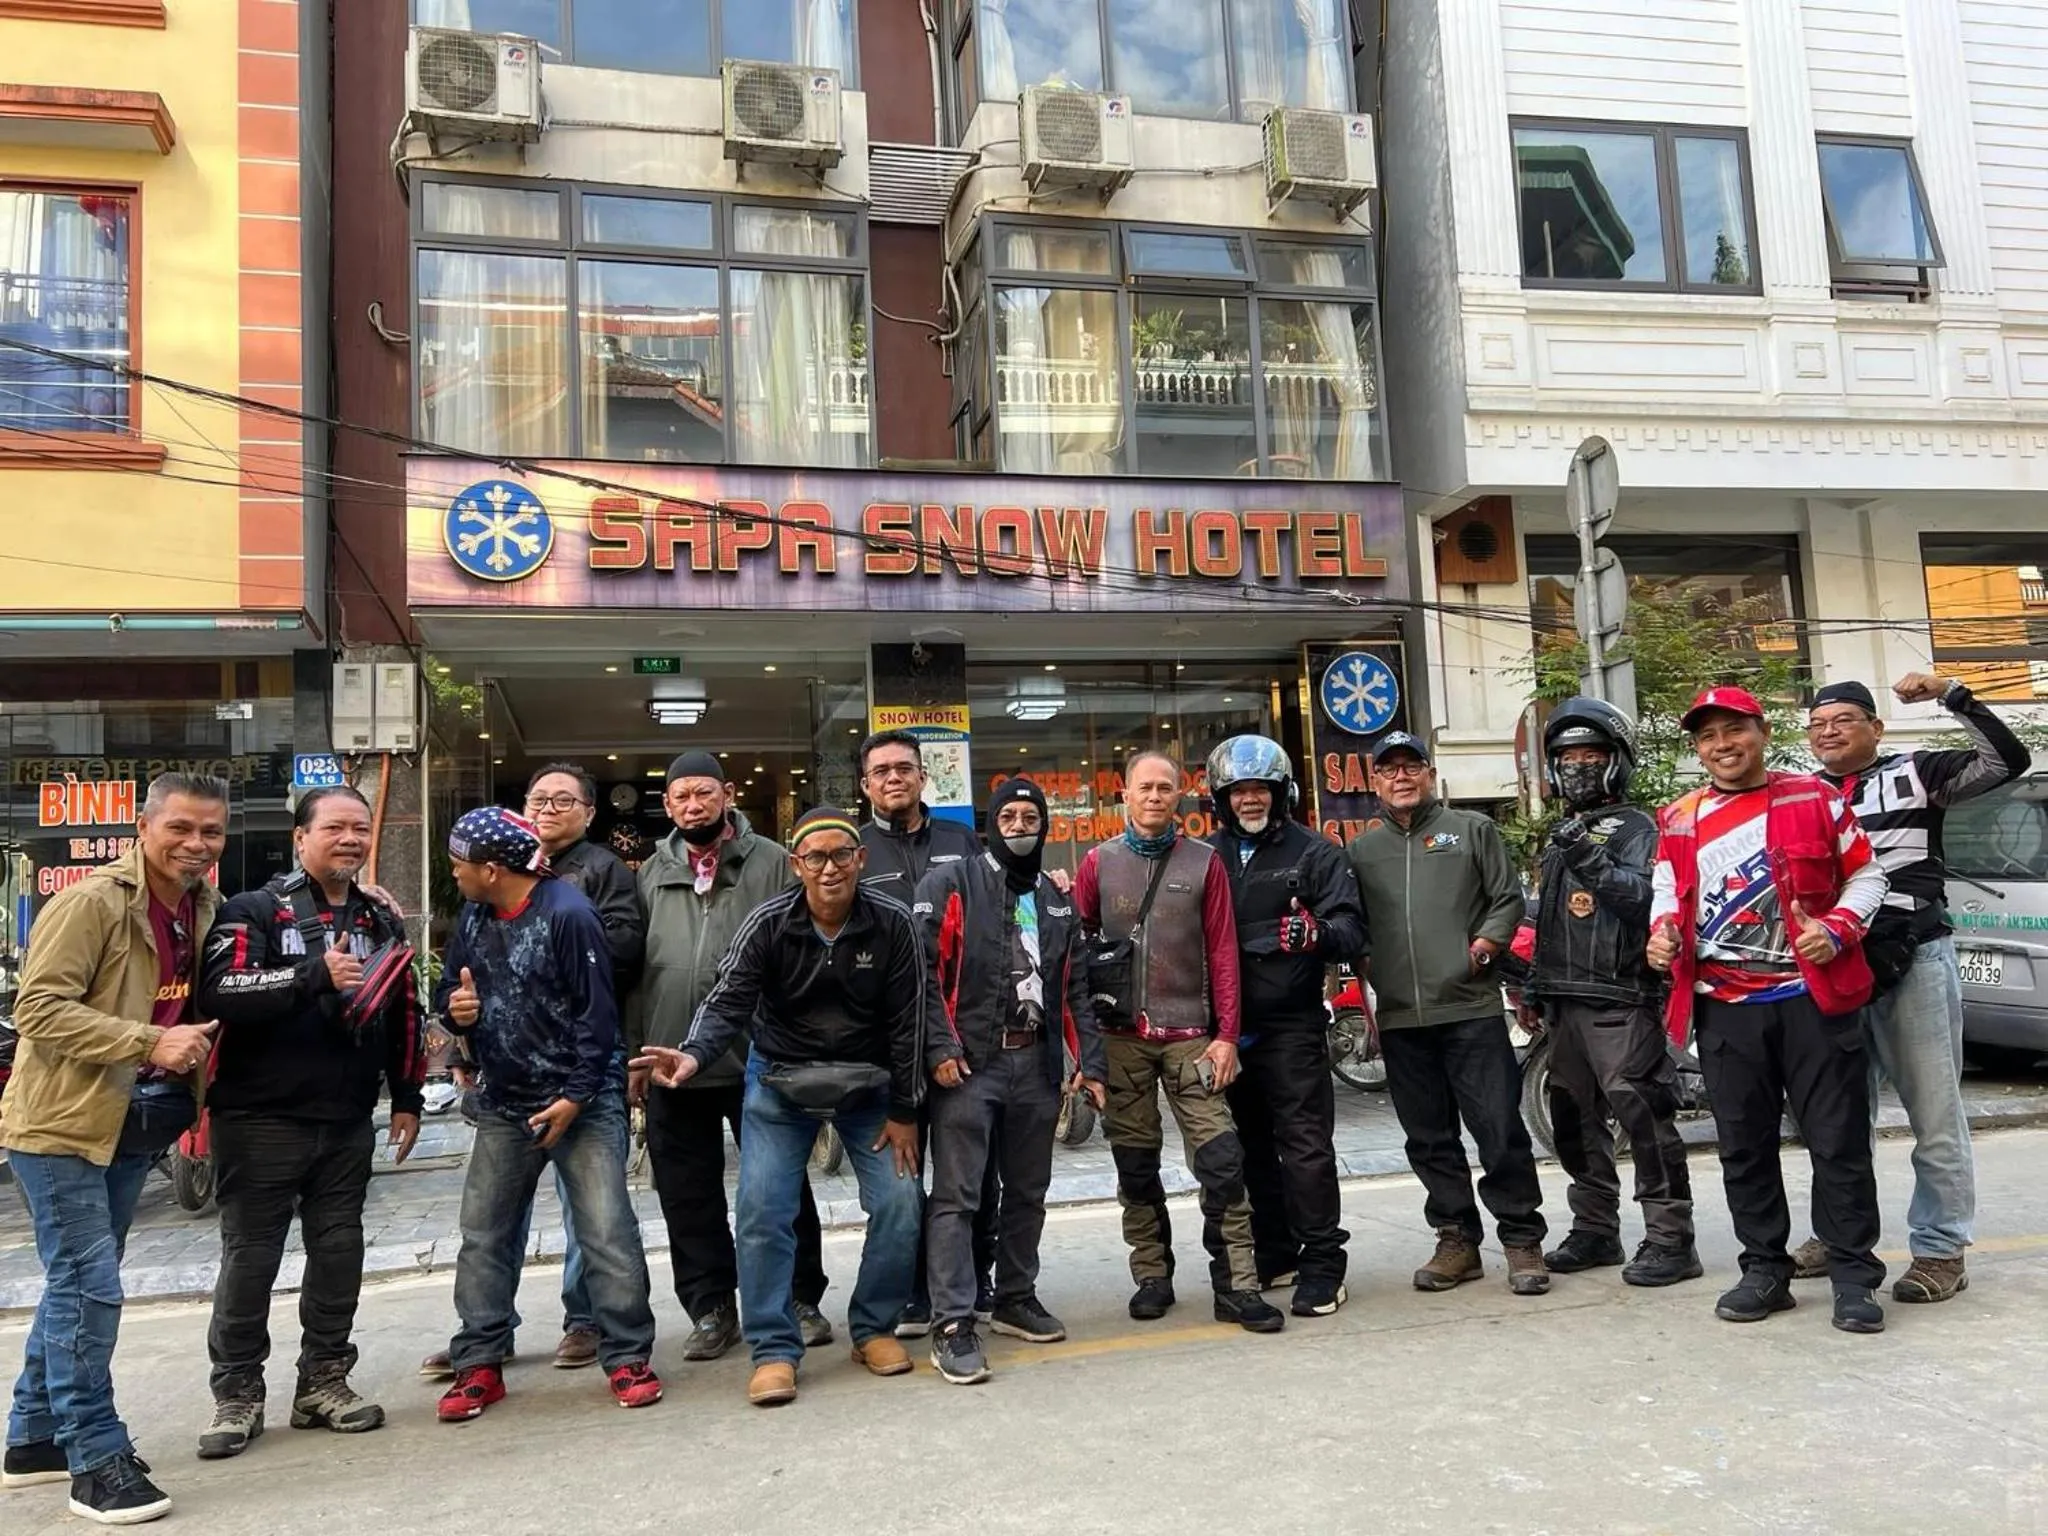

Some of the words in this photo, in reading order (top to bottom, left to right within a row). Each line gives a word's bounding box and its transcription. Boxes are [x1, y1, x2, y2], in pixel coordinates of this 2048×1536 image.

[589, 497, 836, 573] SAPA
[863, 503, 1109, 577] SNOW
[1134, 508, 1388, 577] HOTEL
[879, 711, 919, 725] SNOW
[924, 711, 964, 724] HOTEL
[300, 758, 340, 774] 023
[39, 772, 137, 827] BÌNH
[1969, 950, 1992, 966] 24D
